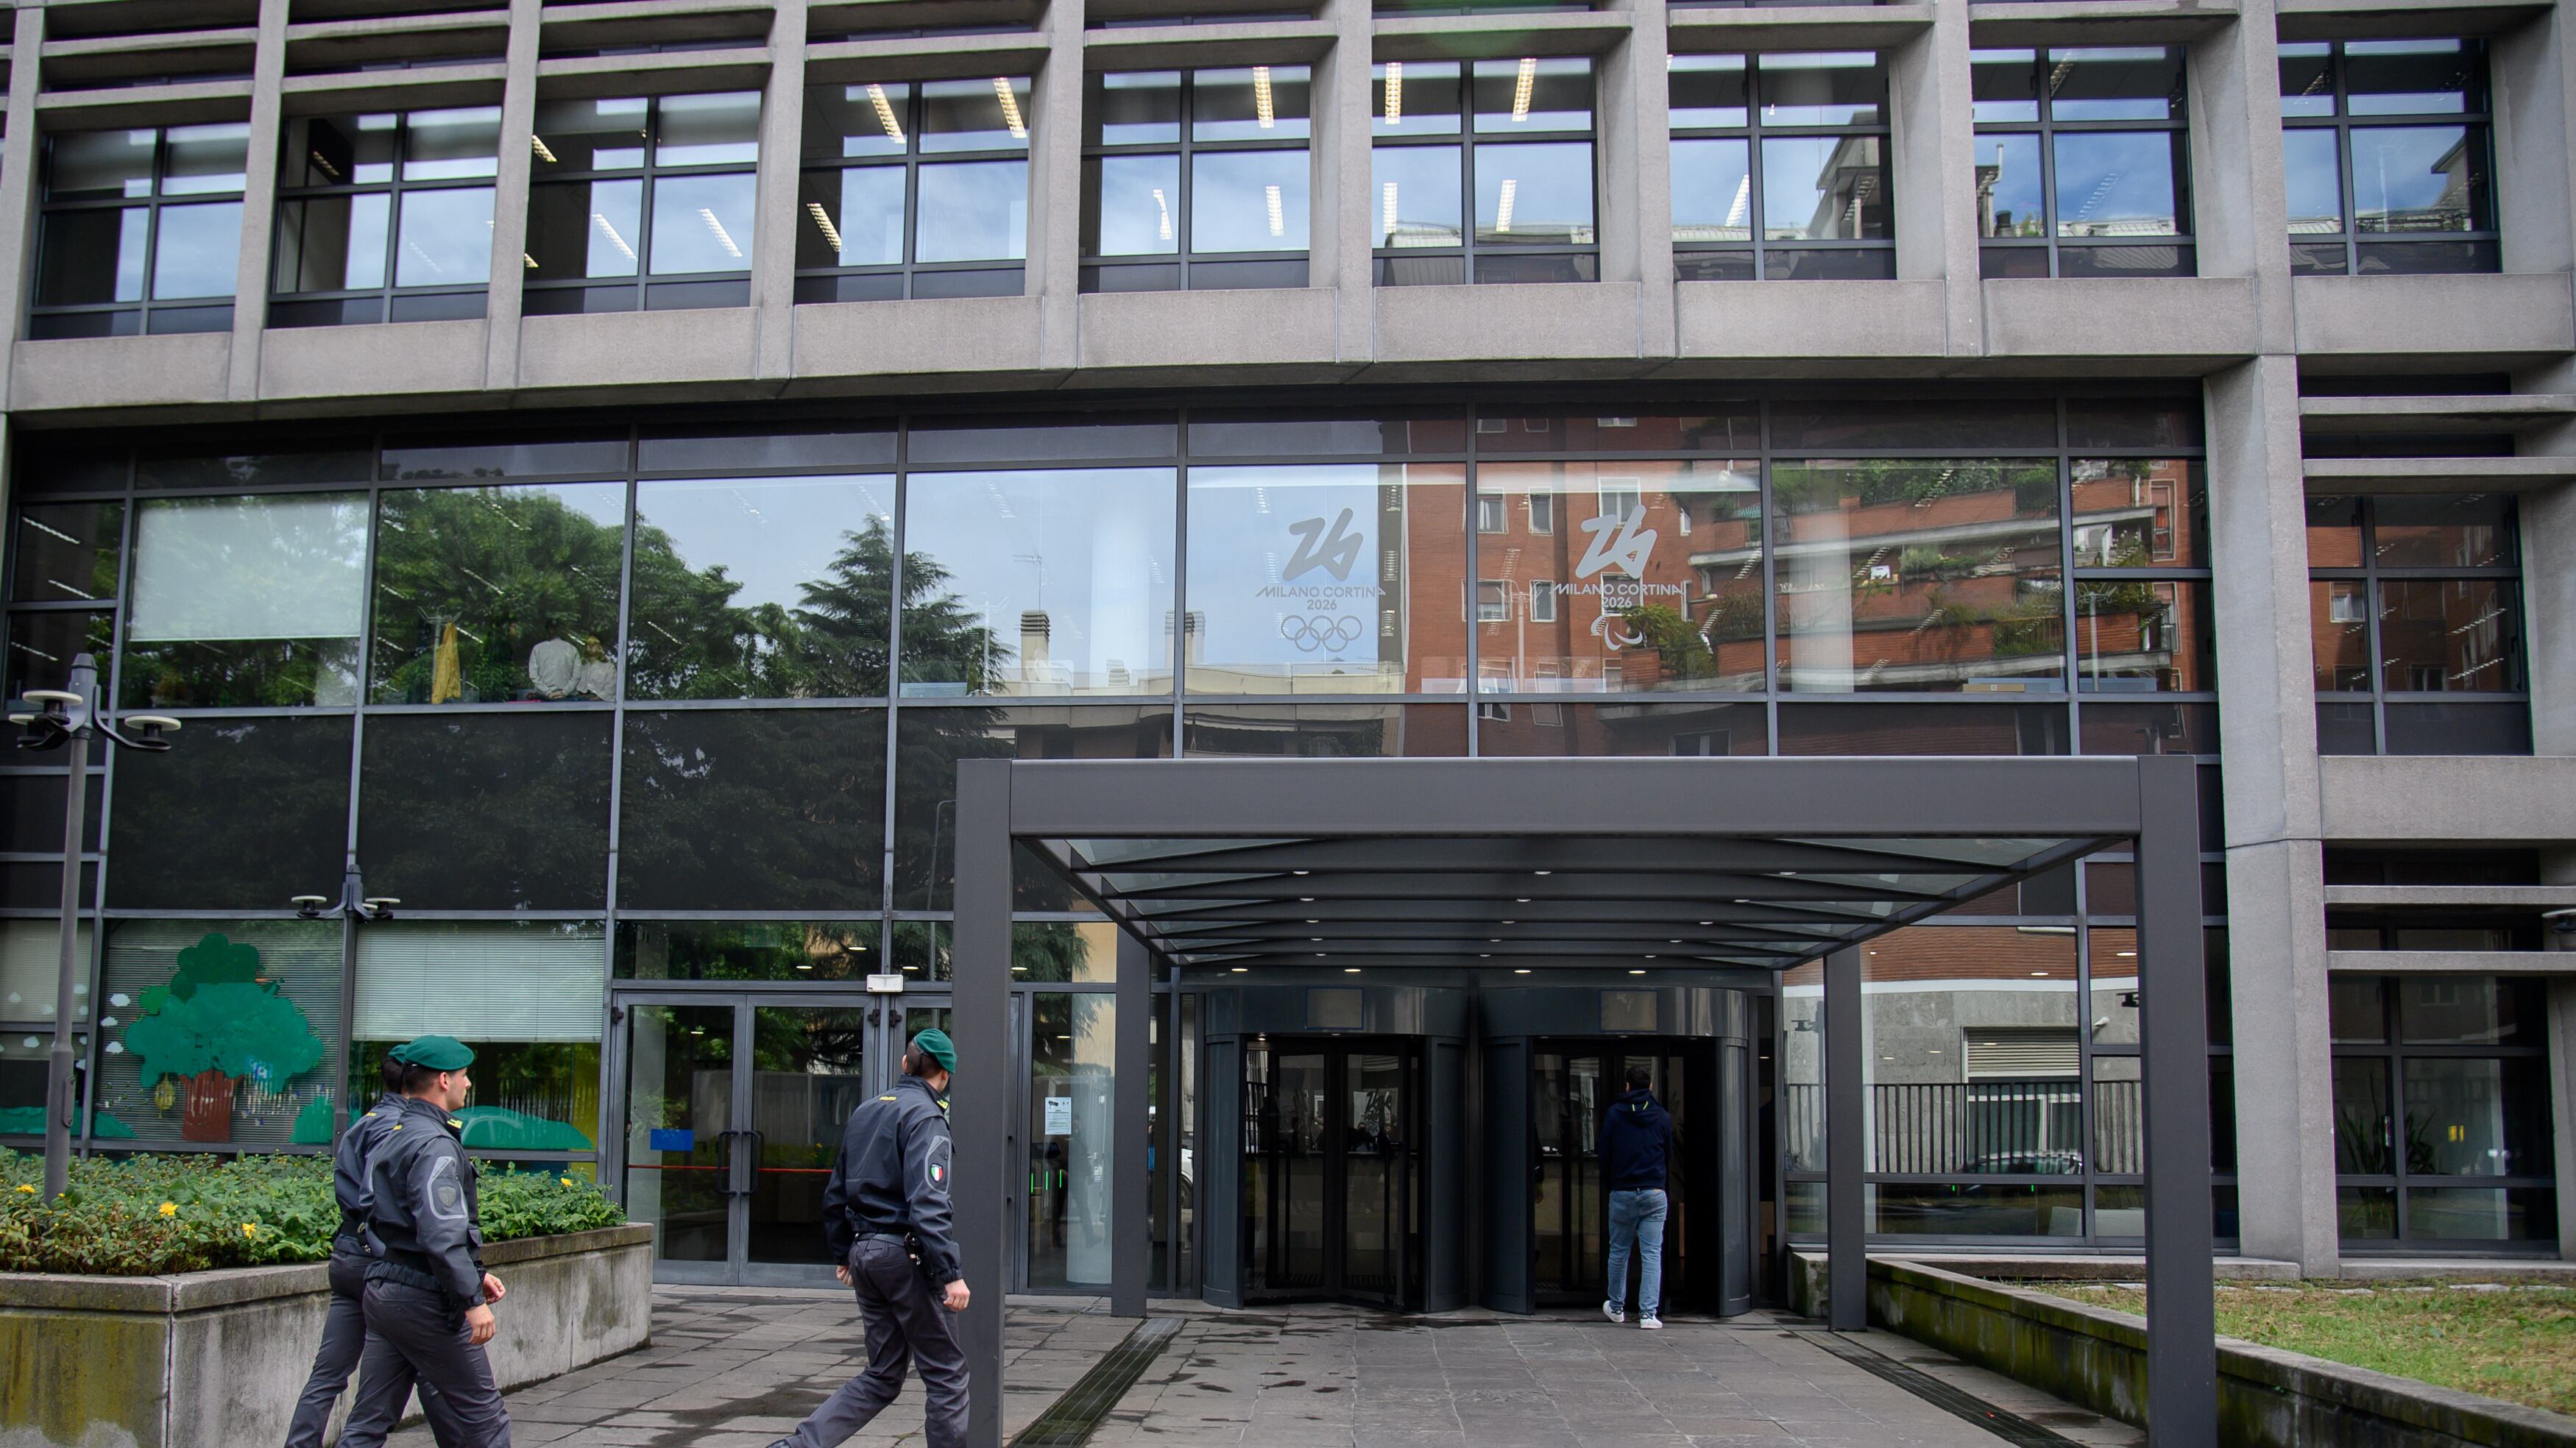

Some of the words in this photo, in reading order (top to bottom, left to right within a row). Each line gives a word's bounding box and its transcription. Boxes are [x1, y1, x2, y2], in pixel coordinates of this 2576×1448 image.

[1256, 586, 1320, 597] MILANO
[1323, 586, 1386, 597] CORTINA
[1549, 583, 1615, 595] MILANO
[1617, 583, 1684, 595] CORTINA
[1306, 599, 1337, 611] 2026
[1602, 597, 1632, 608] 2026
